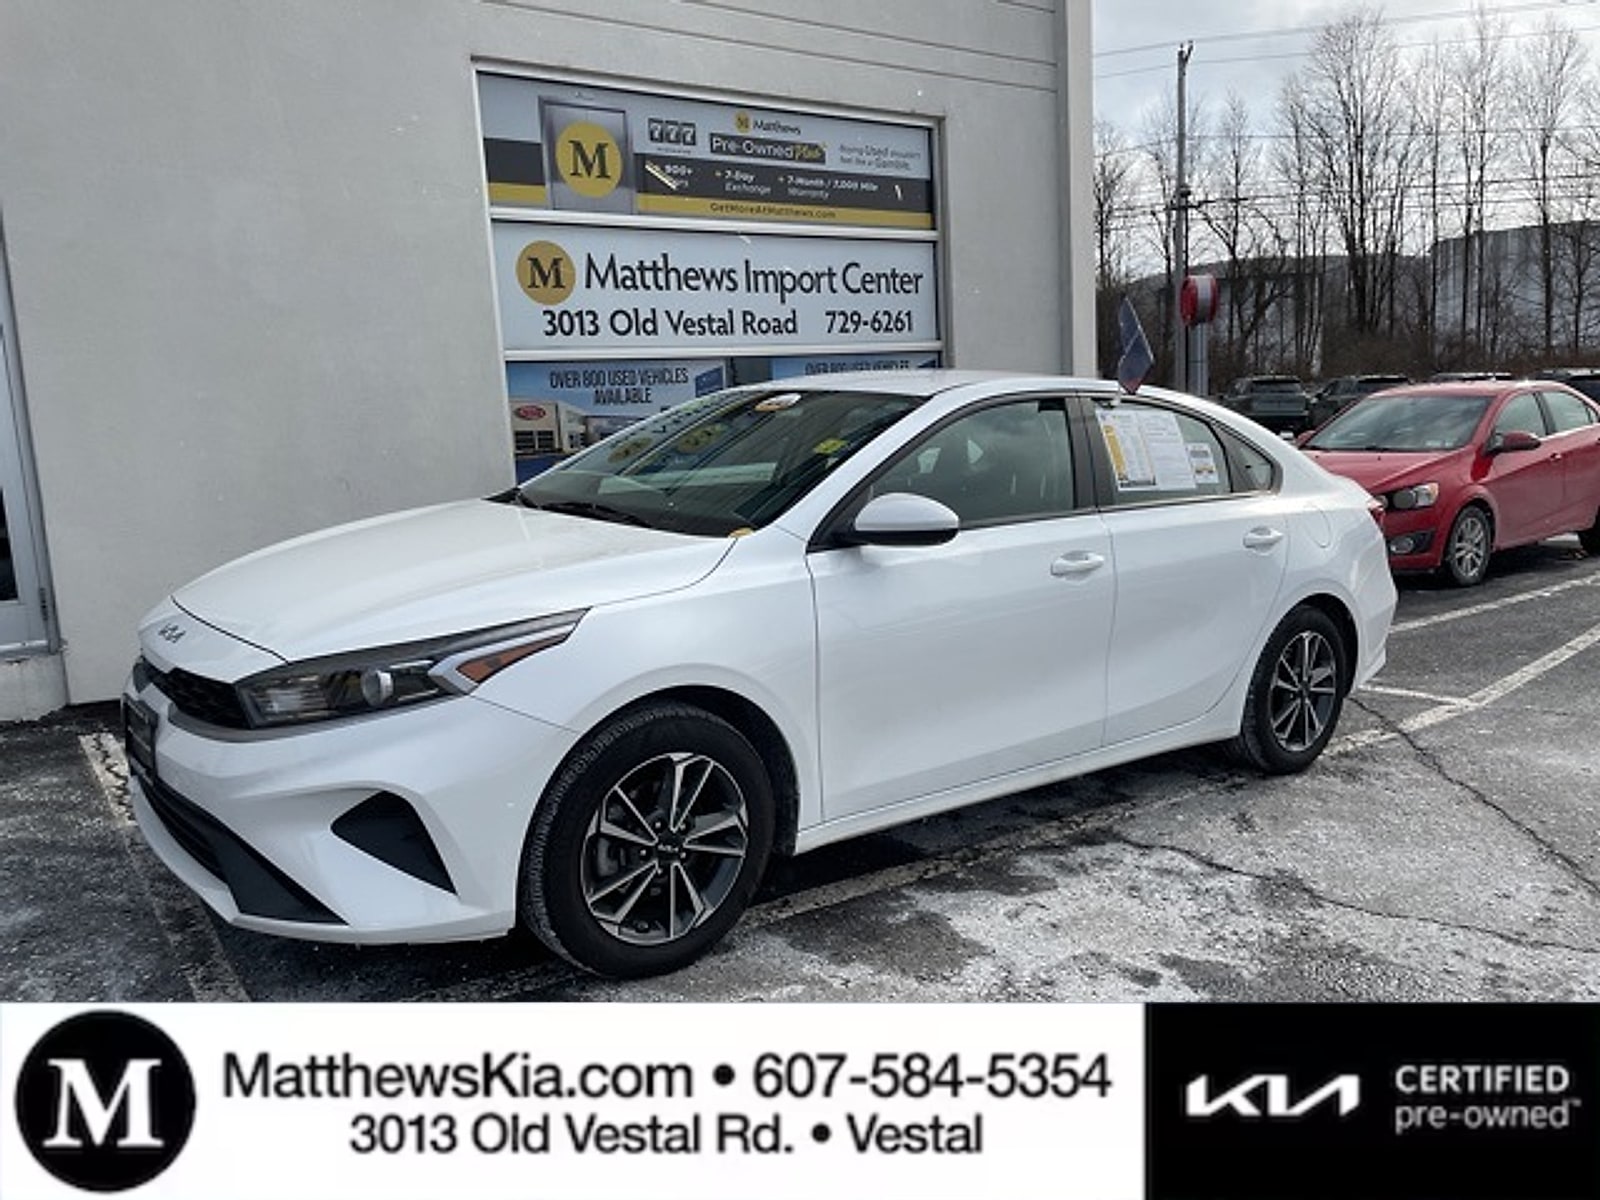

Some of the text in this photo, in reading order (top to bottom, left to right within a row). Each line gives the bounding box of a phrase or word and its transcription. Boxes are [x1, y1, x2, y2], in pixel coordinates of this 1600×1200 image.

[753, 120, 801, 135] Matthews
[568, 140, 611, 179] M
[711, 137, 794, 160] Pre-Owned
[527, 253, 924, 304] M Matthews Import Center
[543, 308, 913, 336] 3013 Old Vestal Road 729-6261
[550, 369, 581, 388] OVER
[609, 367, 636, 386] USED
[638, 367, 688, 385] VEHICLES
[594, 388, 653, 405] AVAILABLE
